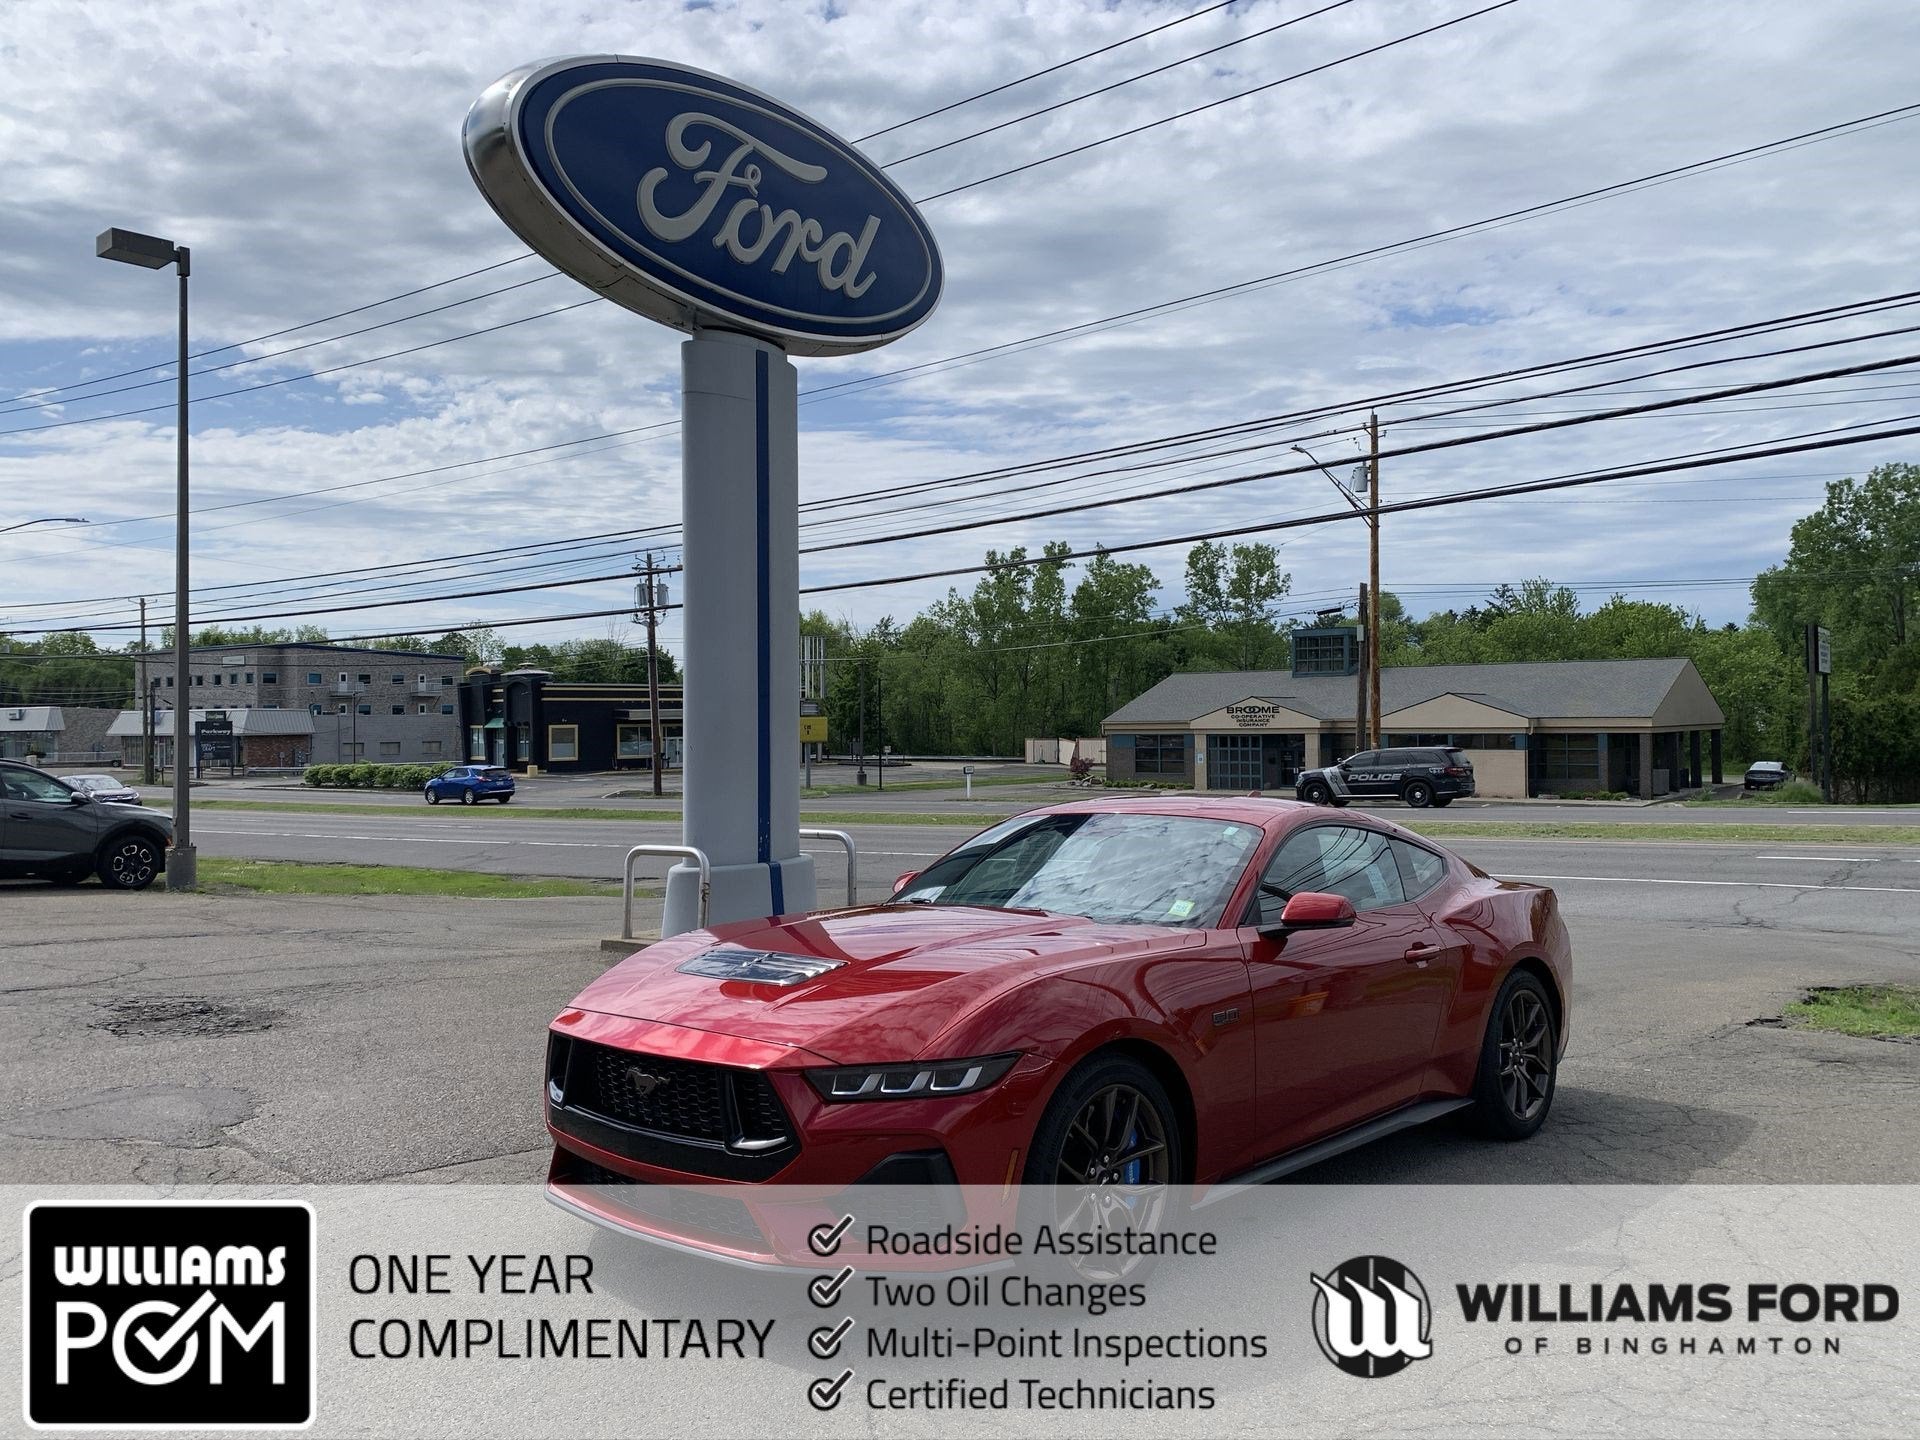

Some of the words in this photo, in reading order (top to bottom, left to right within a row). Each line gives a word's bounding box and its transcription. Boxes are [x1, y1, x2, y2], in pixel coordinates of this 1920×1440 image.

[636, 112, 881, 299] Ford
[1226, 706, 1280, 714] BROOME
[1347, 773, 1402, 781] POLICE
